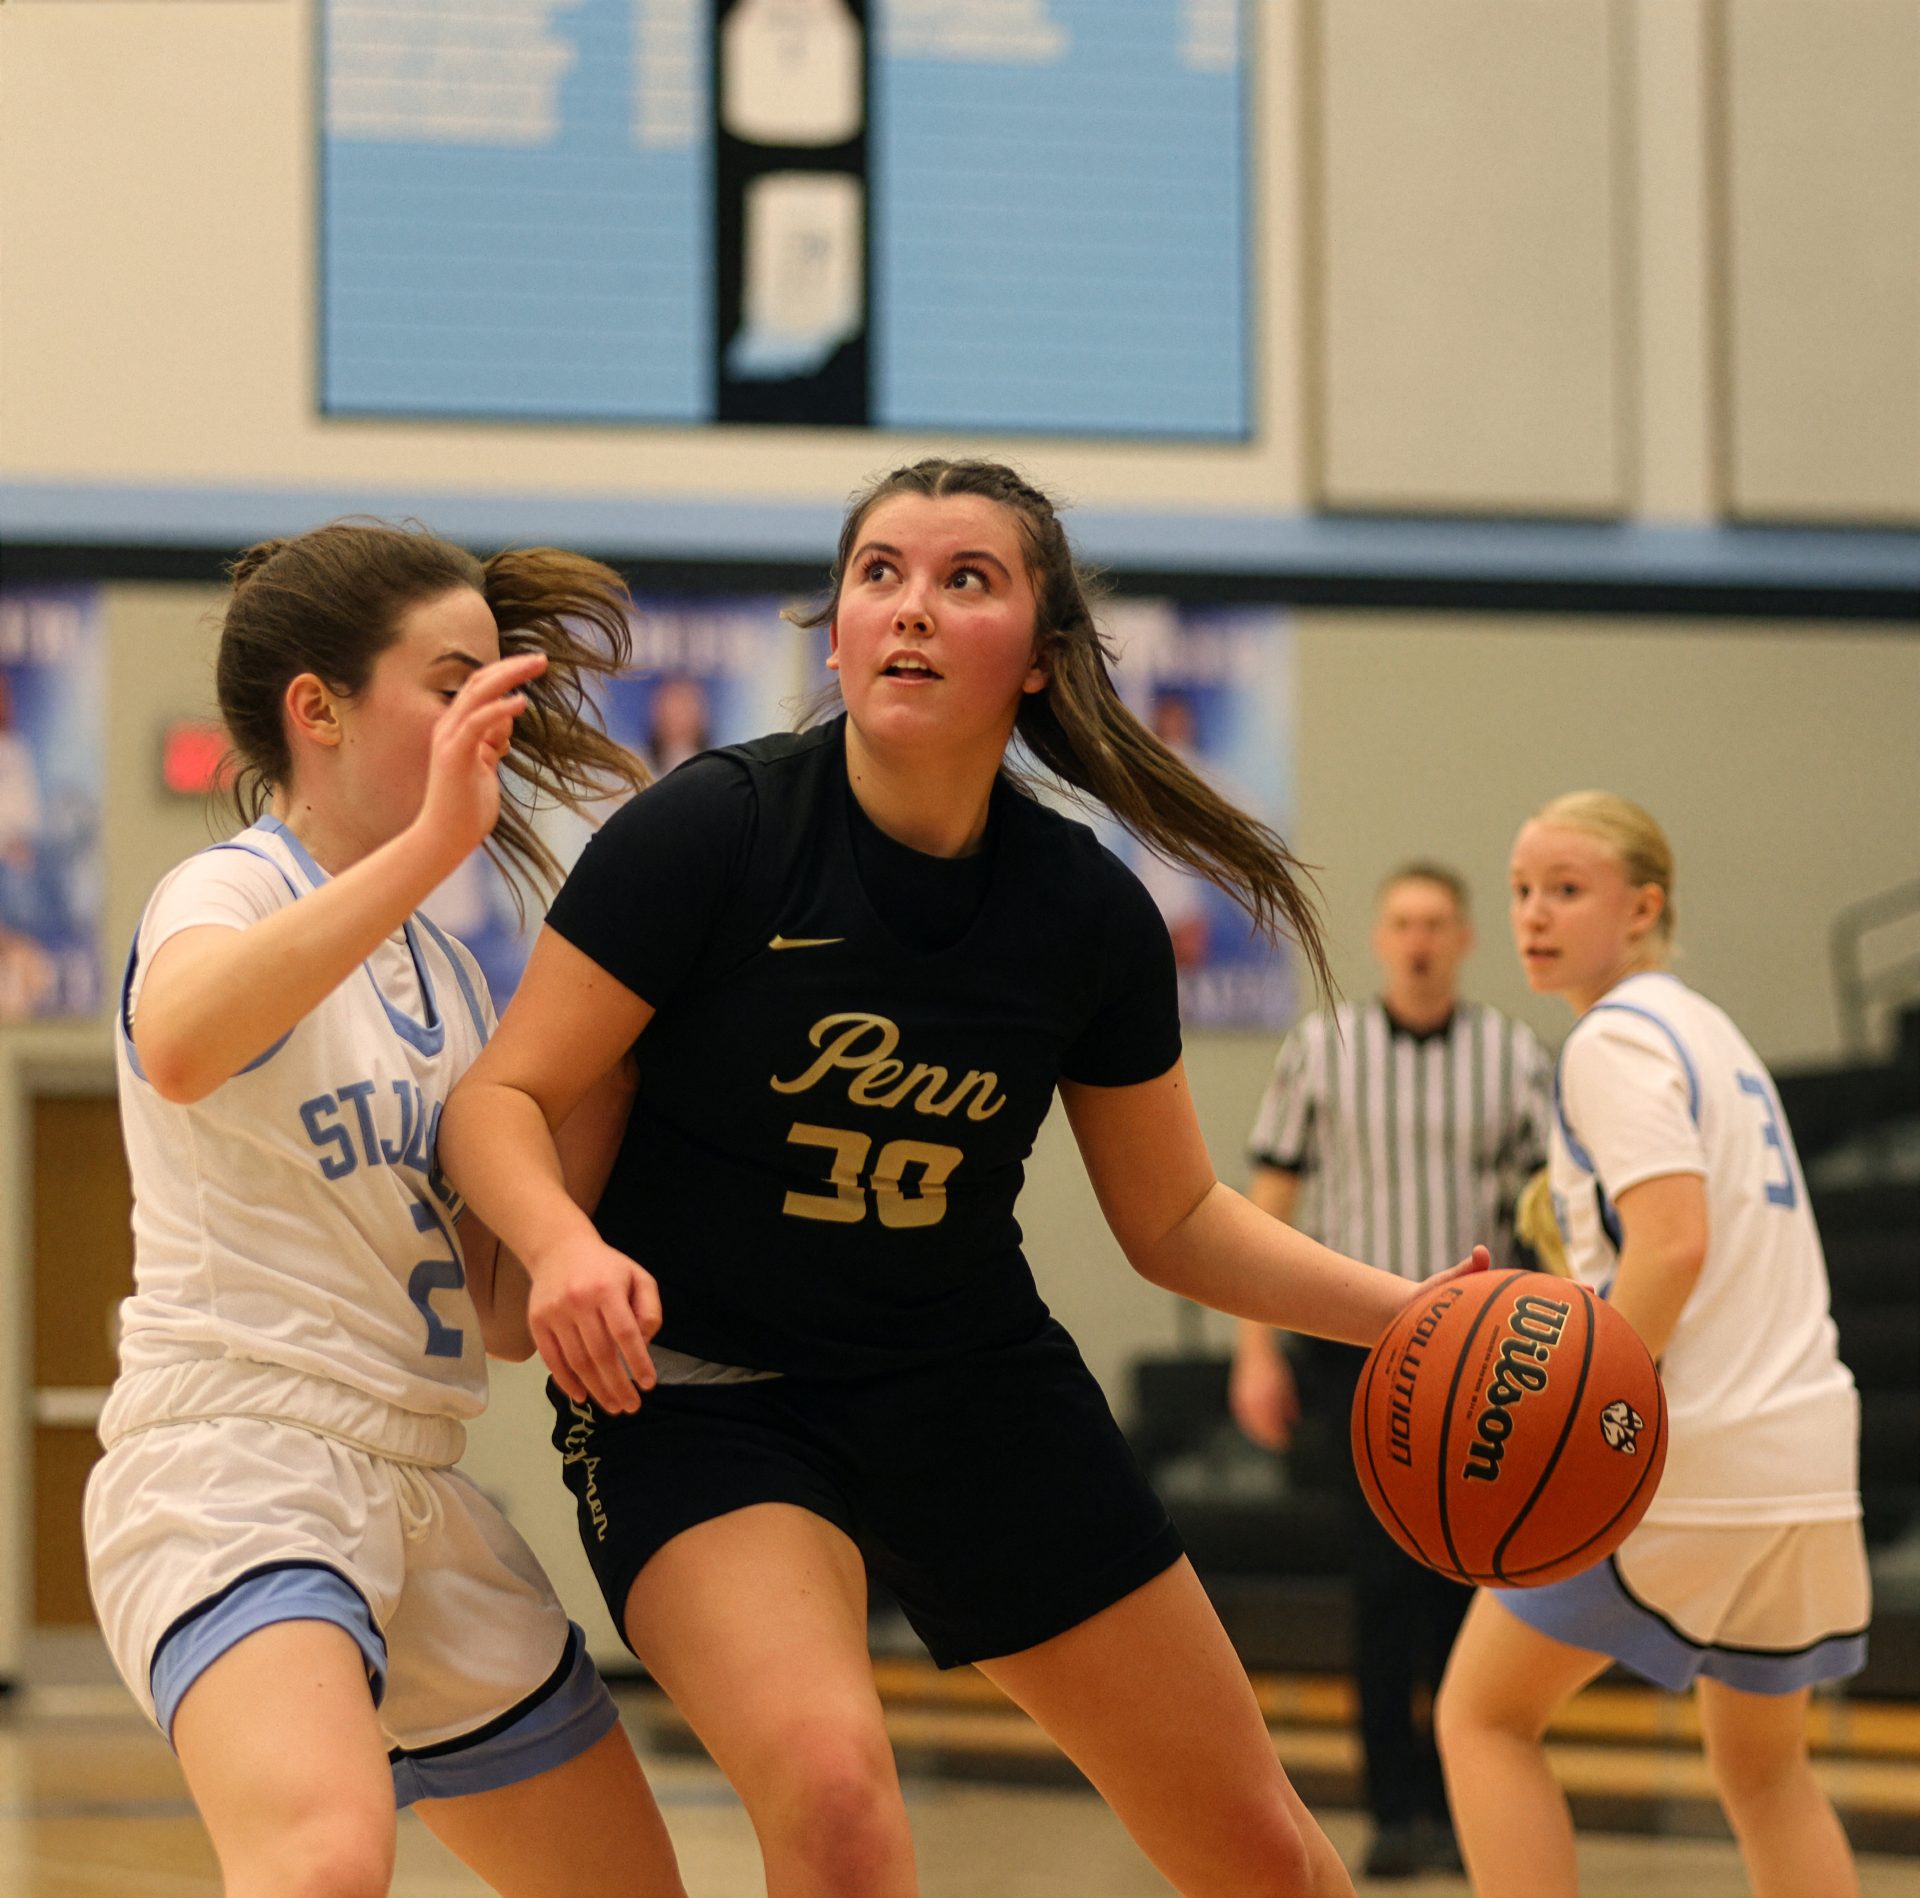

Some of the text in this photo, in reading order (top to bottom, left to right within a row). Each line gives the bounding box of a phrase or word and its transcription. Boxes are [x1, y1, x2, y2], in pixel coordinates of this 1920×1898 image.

[770, 1012, 1007, 1121] Penn
[782, 1121, 964, 1228] 30
[1737, 1070, 1797, 1210] 3
[408, 1203, 465, 1358] 2
[1462, 1295, 1571, 1483] Wilson
